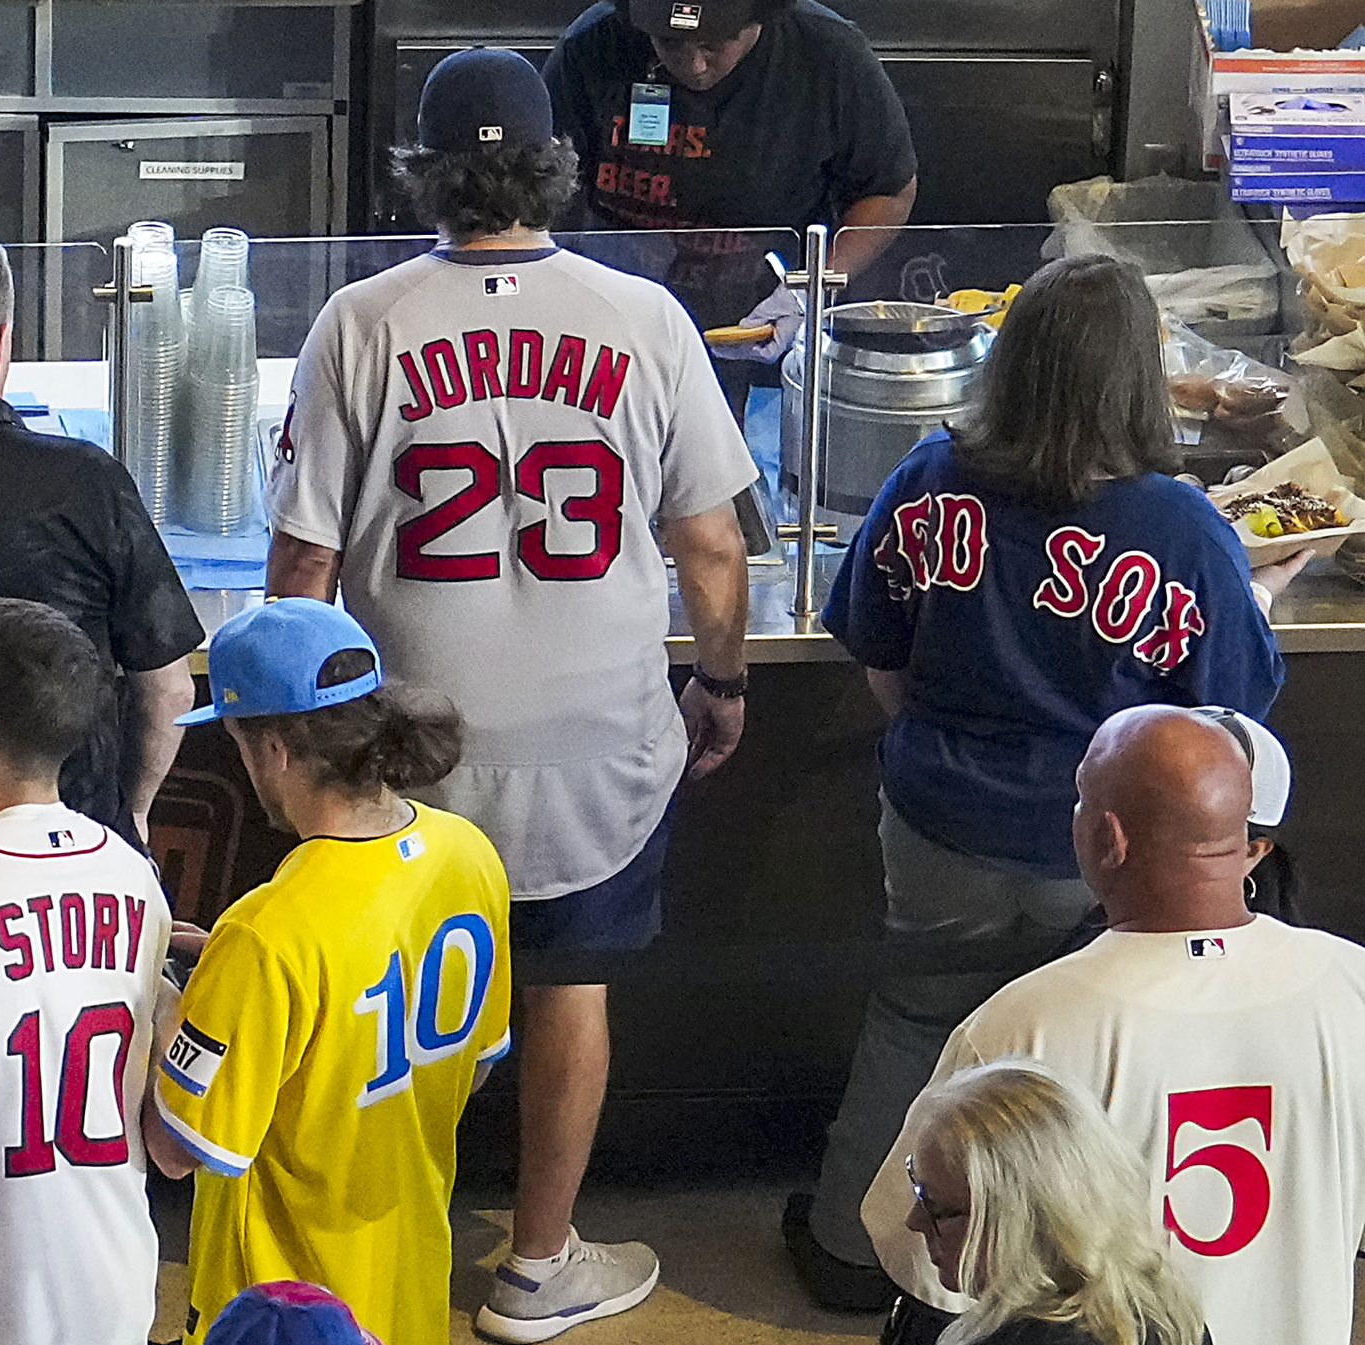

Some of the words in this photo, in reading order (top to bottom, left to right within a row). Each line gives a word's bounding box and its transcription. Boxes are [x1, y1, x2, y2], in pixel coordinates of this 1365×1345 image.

[145, 166, 190, 175] CLEANING
[192, 166, 234, 175] SUPPLIES
[610, 115, 712, 158] TAS.
[396, 328, 631, 423] JORDAN
[393, 439, 625, 582] 23
[169, 1033, 202, 1071] 617
[353, 912, 496, 1110] 10
[4, 1001, 136, 1179] 10
[1163, 1085, 1272, 1257] 5
